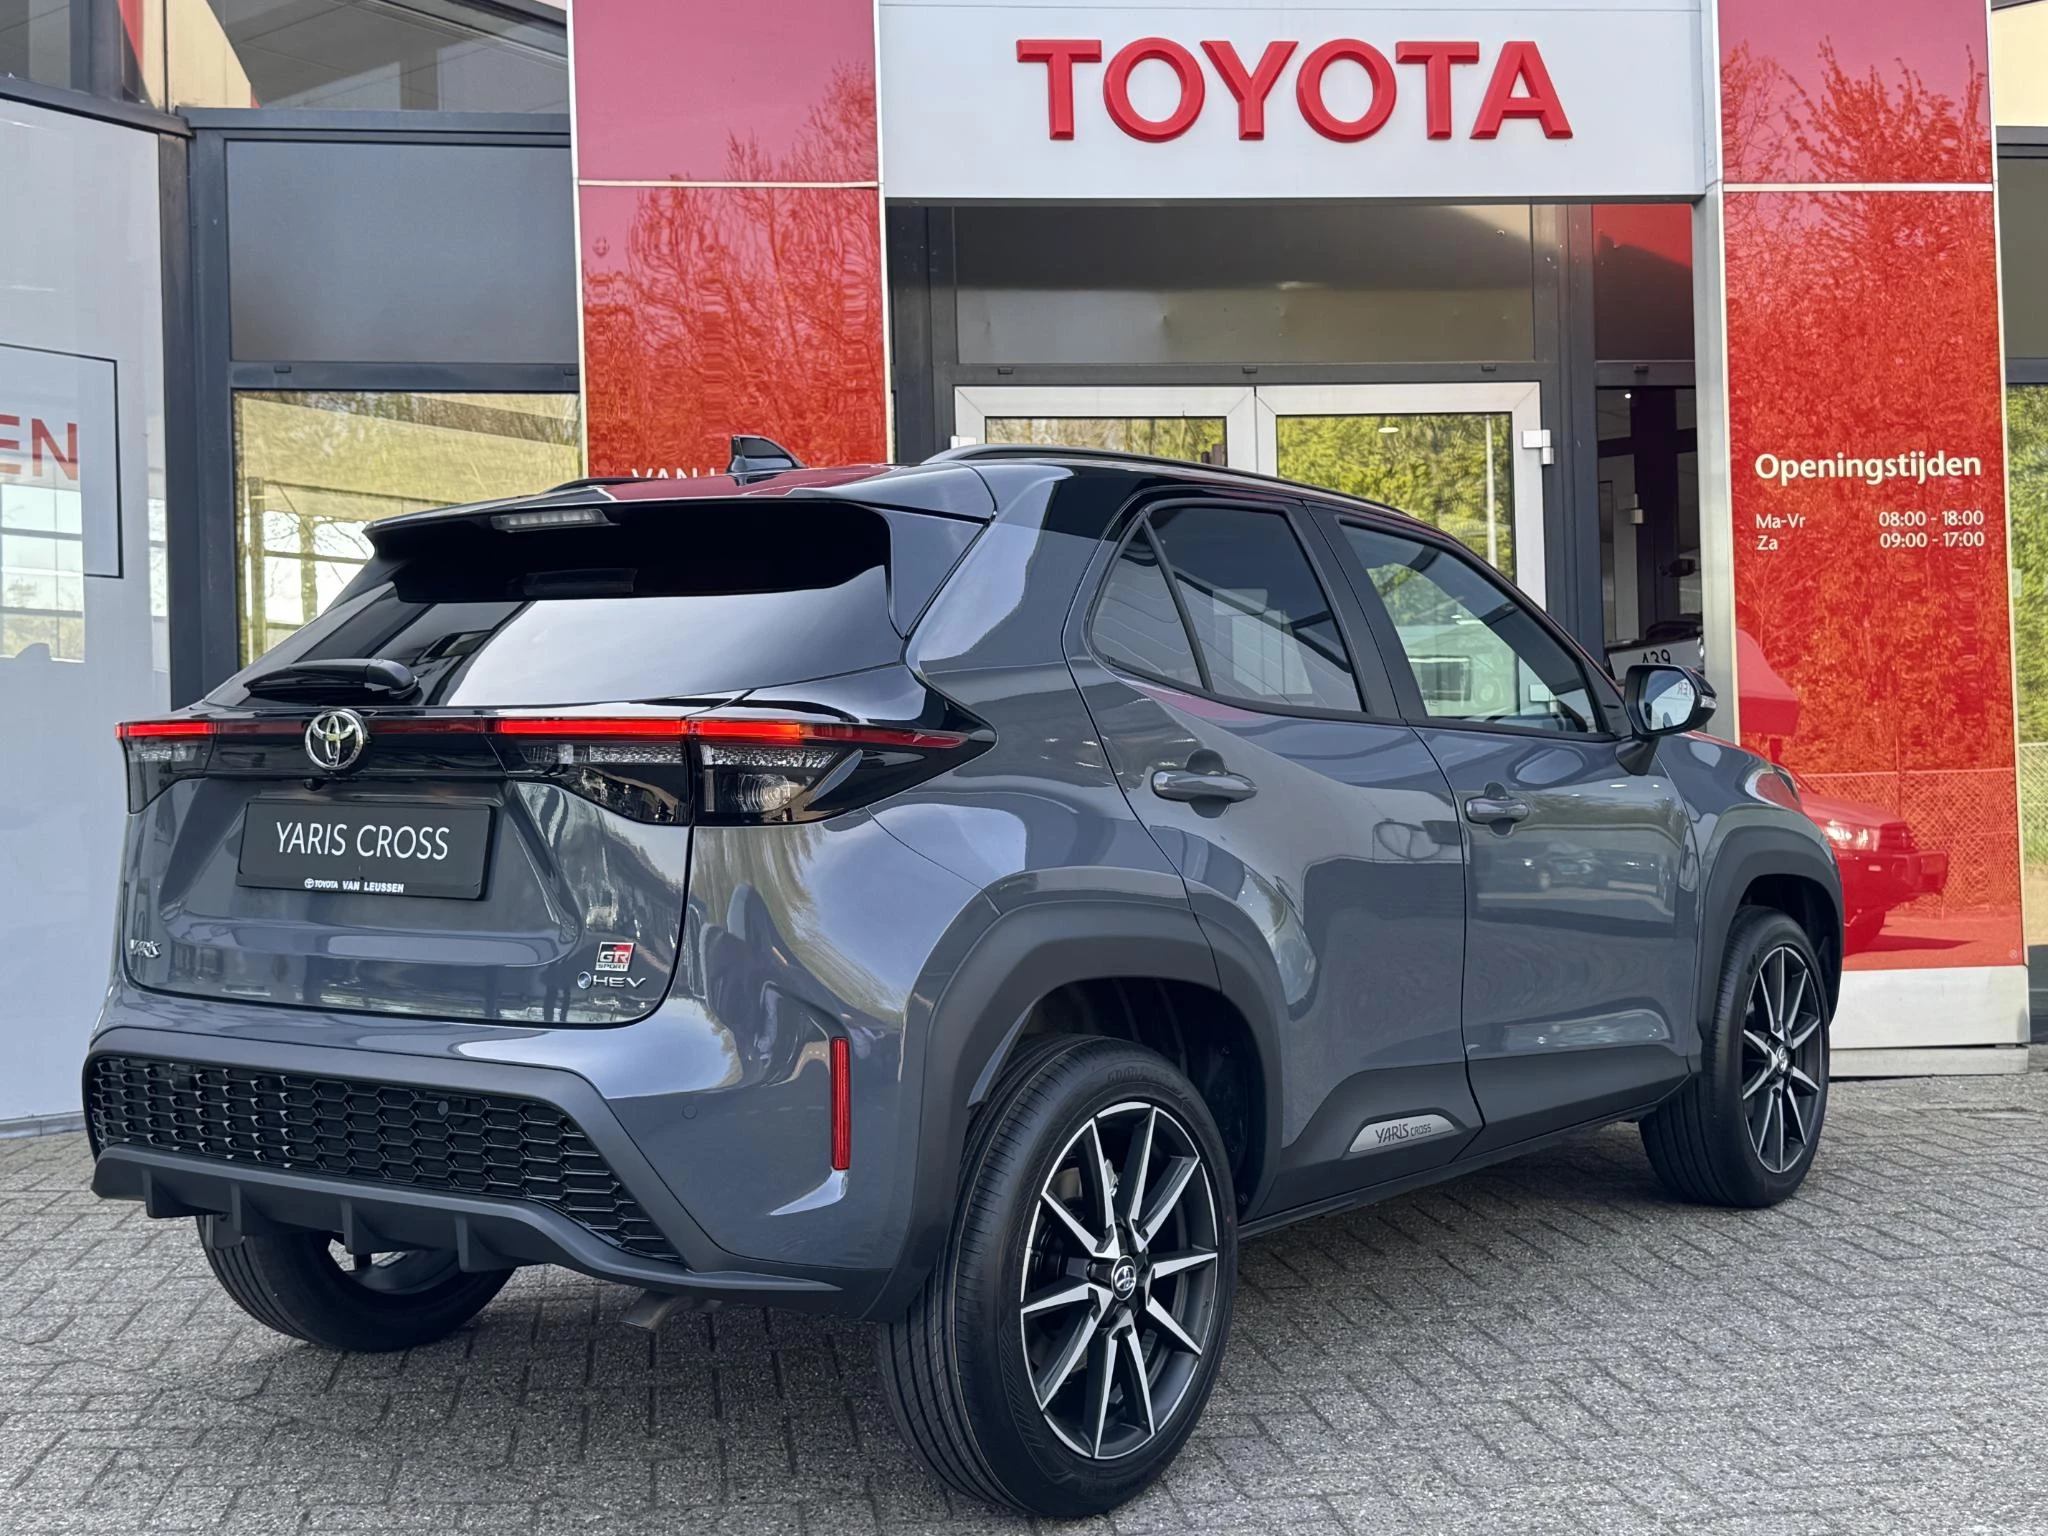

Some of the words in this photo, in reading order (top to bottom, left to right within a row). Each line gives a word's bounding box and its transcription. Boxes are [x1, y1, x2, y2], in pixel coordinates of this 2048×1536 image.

[1016, 37, 1573, 143] TOYOTA
[1754, 450, 1982, 486] Openingstijden
[1755, 513, 1806, 529] Ma-Vr
[1879, 511, 1927, 527] 08:00
[1942, 510, 1984, 526] 18:00
[1757, 535, 1779, 551] Za
[1880, 532, 1928, 548] 09:00
[1943, 531, 1985, 547] 17:00
[276, 821, 348, 856] YARIS
[356, 824, 450, 861] CROSS
[315, 879, 339, 889] TOYOTA
[342, 880, 360, 891] VAN
[364, 881, 405, 894] LEUSSEN
[599, 951, 630, 963] GR
[592, 975, 646, 988] HEV
[1375, 1123, 1409, 1144] YARIS
[1410, 1123, 1432, 1137] CROSS
